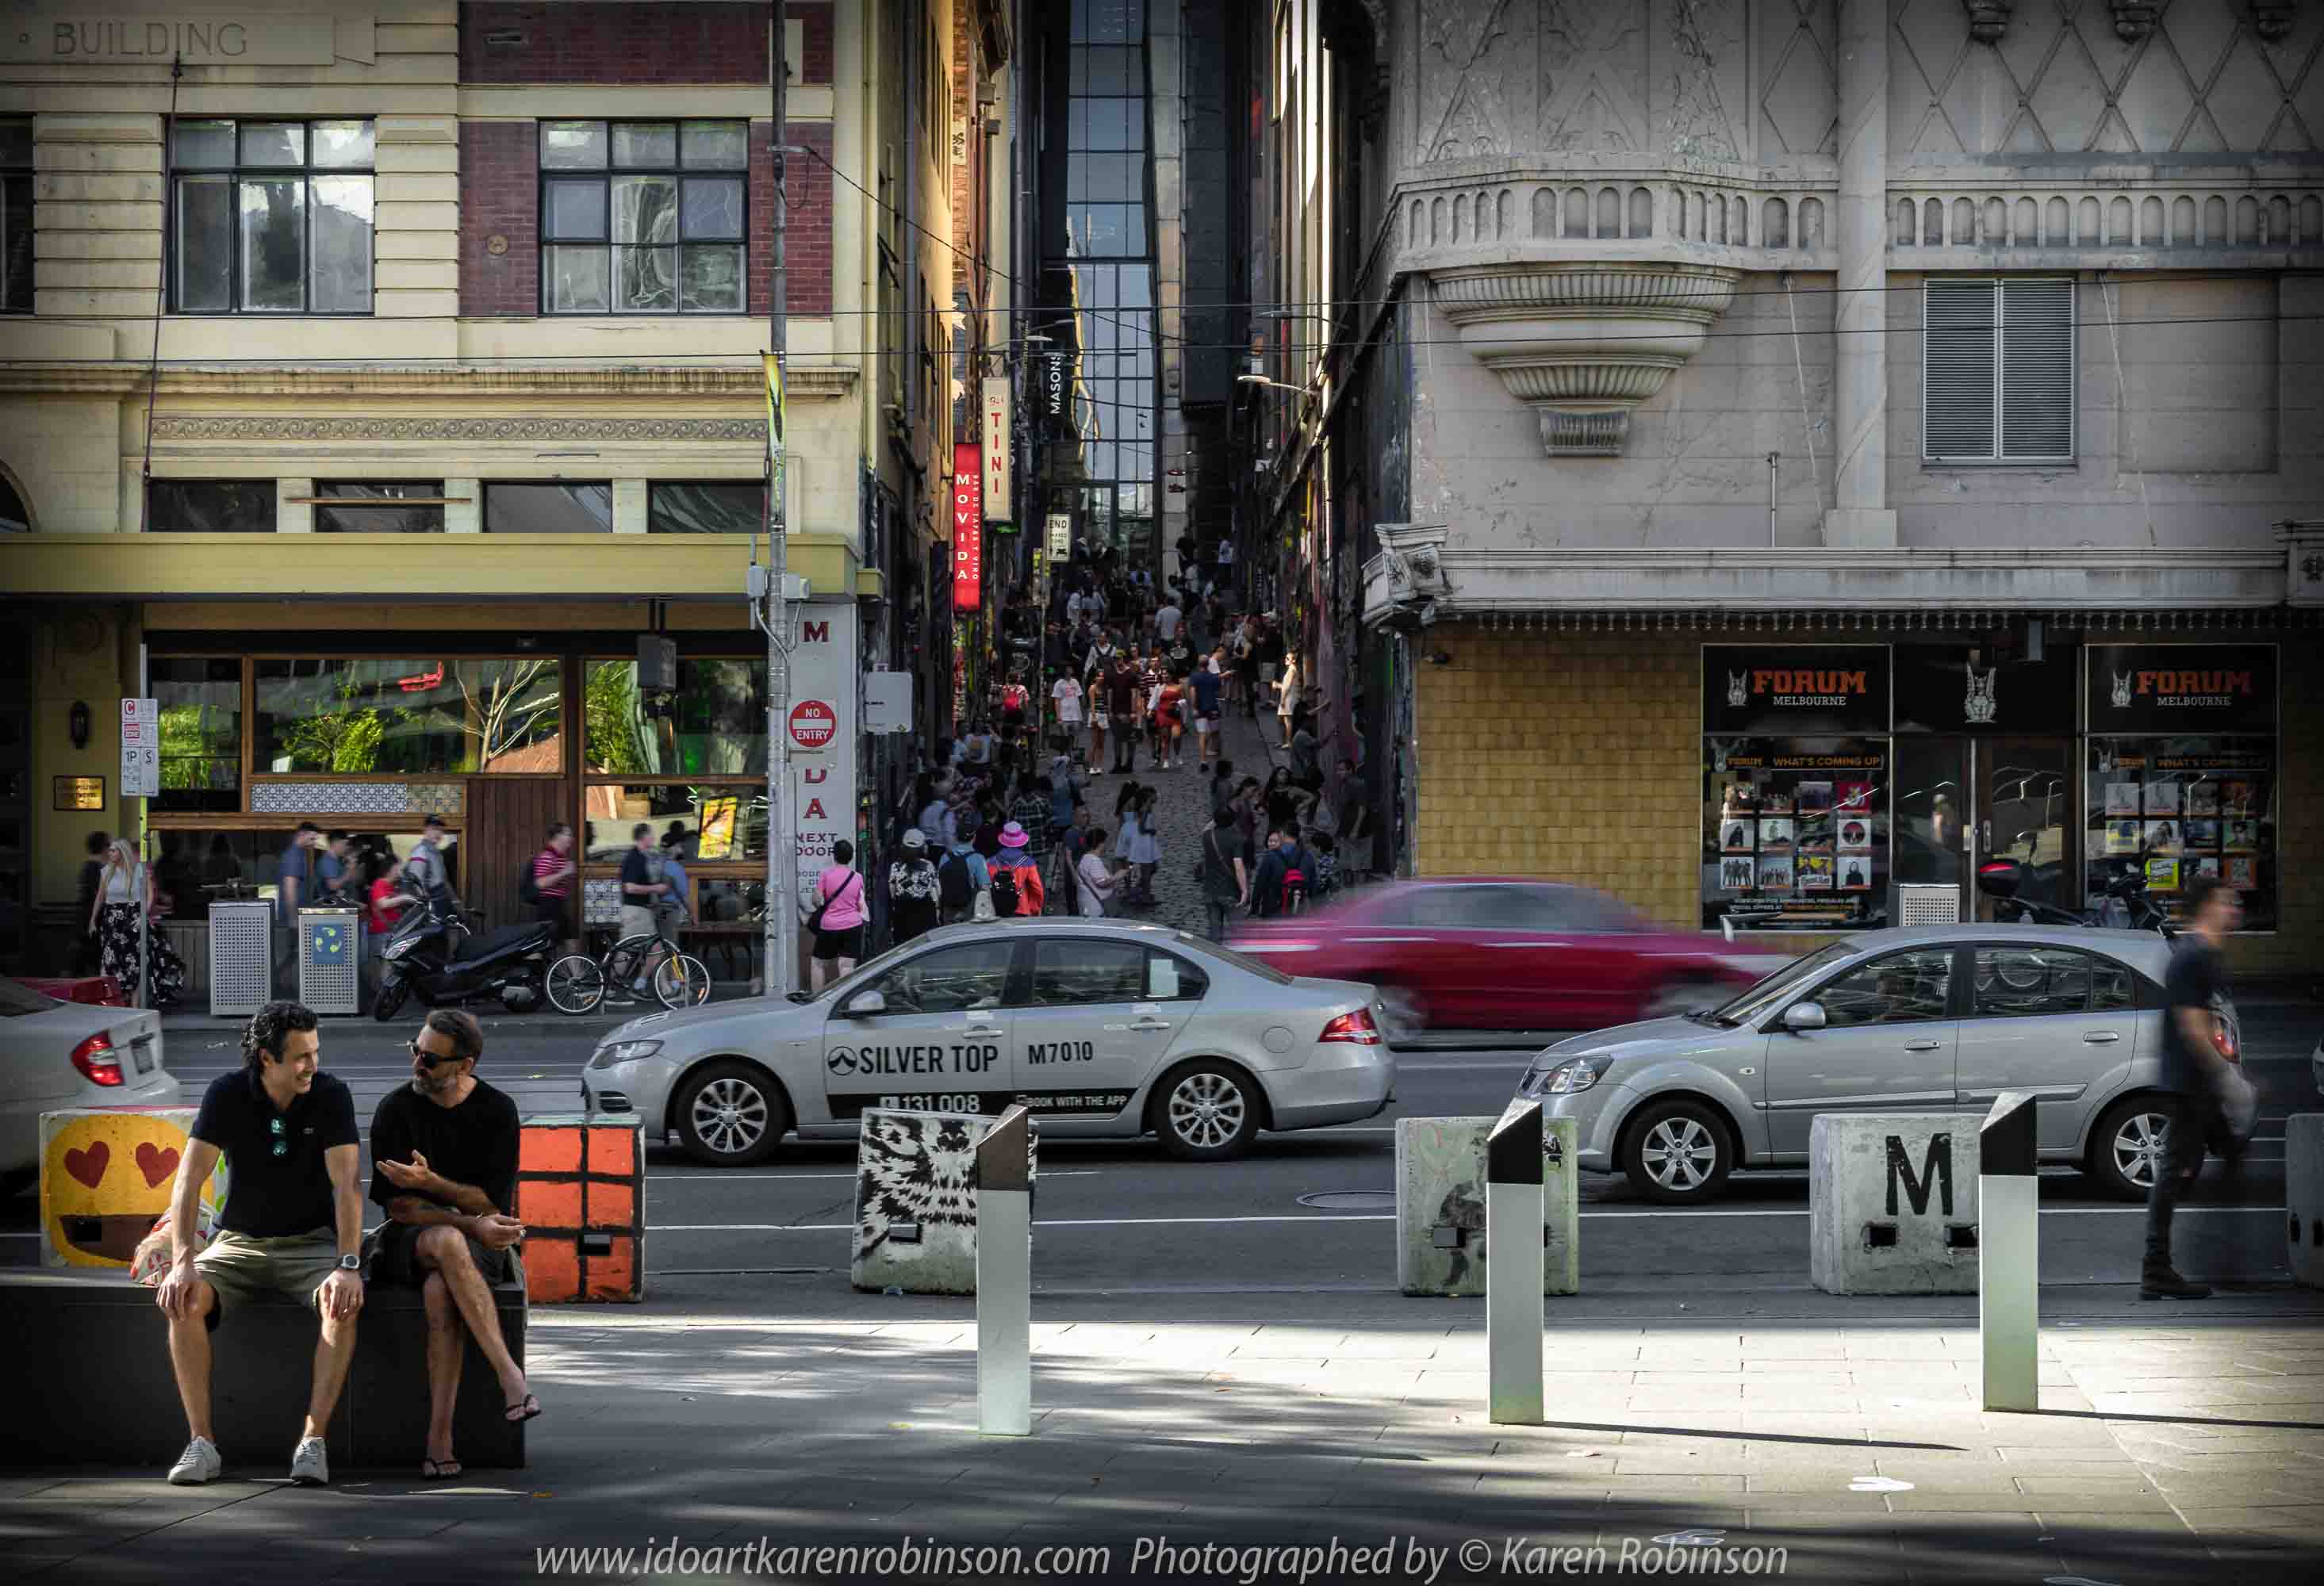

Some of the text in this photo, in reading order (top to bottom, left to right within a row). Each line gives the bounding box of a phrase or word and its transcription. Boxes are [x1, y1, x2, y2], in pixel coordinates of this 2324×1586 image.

[53, 22, 247, 56] BUILDING
[1049, 356, 1060, 414] MASONS
[991, 412, 1002, 494] TINI
[956, 473, 971, 580] MOVIDA
[1049, 519, 1067, 528] END
[1752, 671, 1866, 694] FORUM
[2136, 671, 2253, 695] FORUM
[1773, 696, 1847, 706] MELBOURNE
[2157, 696, 2232, 707] MELBOURNE
[805, 708, 820, 718] NO
[796, 730, 829, 740] ENTRY
[1774, 755, 1815, 766] WHAT'S
[1816, 755, 1862, 766] COMING
[1865, 755, 1880, 767] UP
[796, 833, 838, 843] NEXT
[860, 1044, 999, 1075] SILVER TOP
[1028, 1041, 1094, 1065] M7010
[901, 1094, 980, 1113] 131 008
[1056, 1095, 1083, 1107] WITH
[1086, 1095, 1104, 1106] THE
[1106, 1094, 1128, 1106] APP
[1885, 1132, 1954, 1216] M
